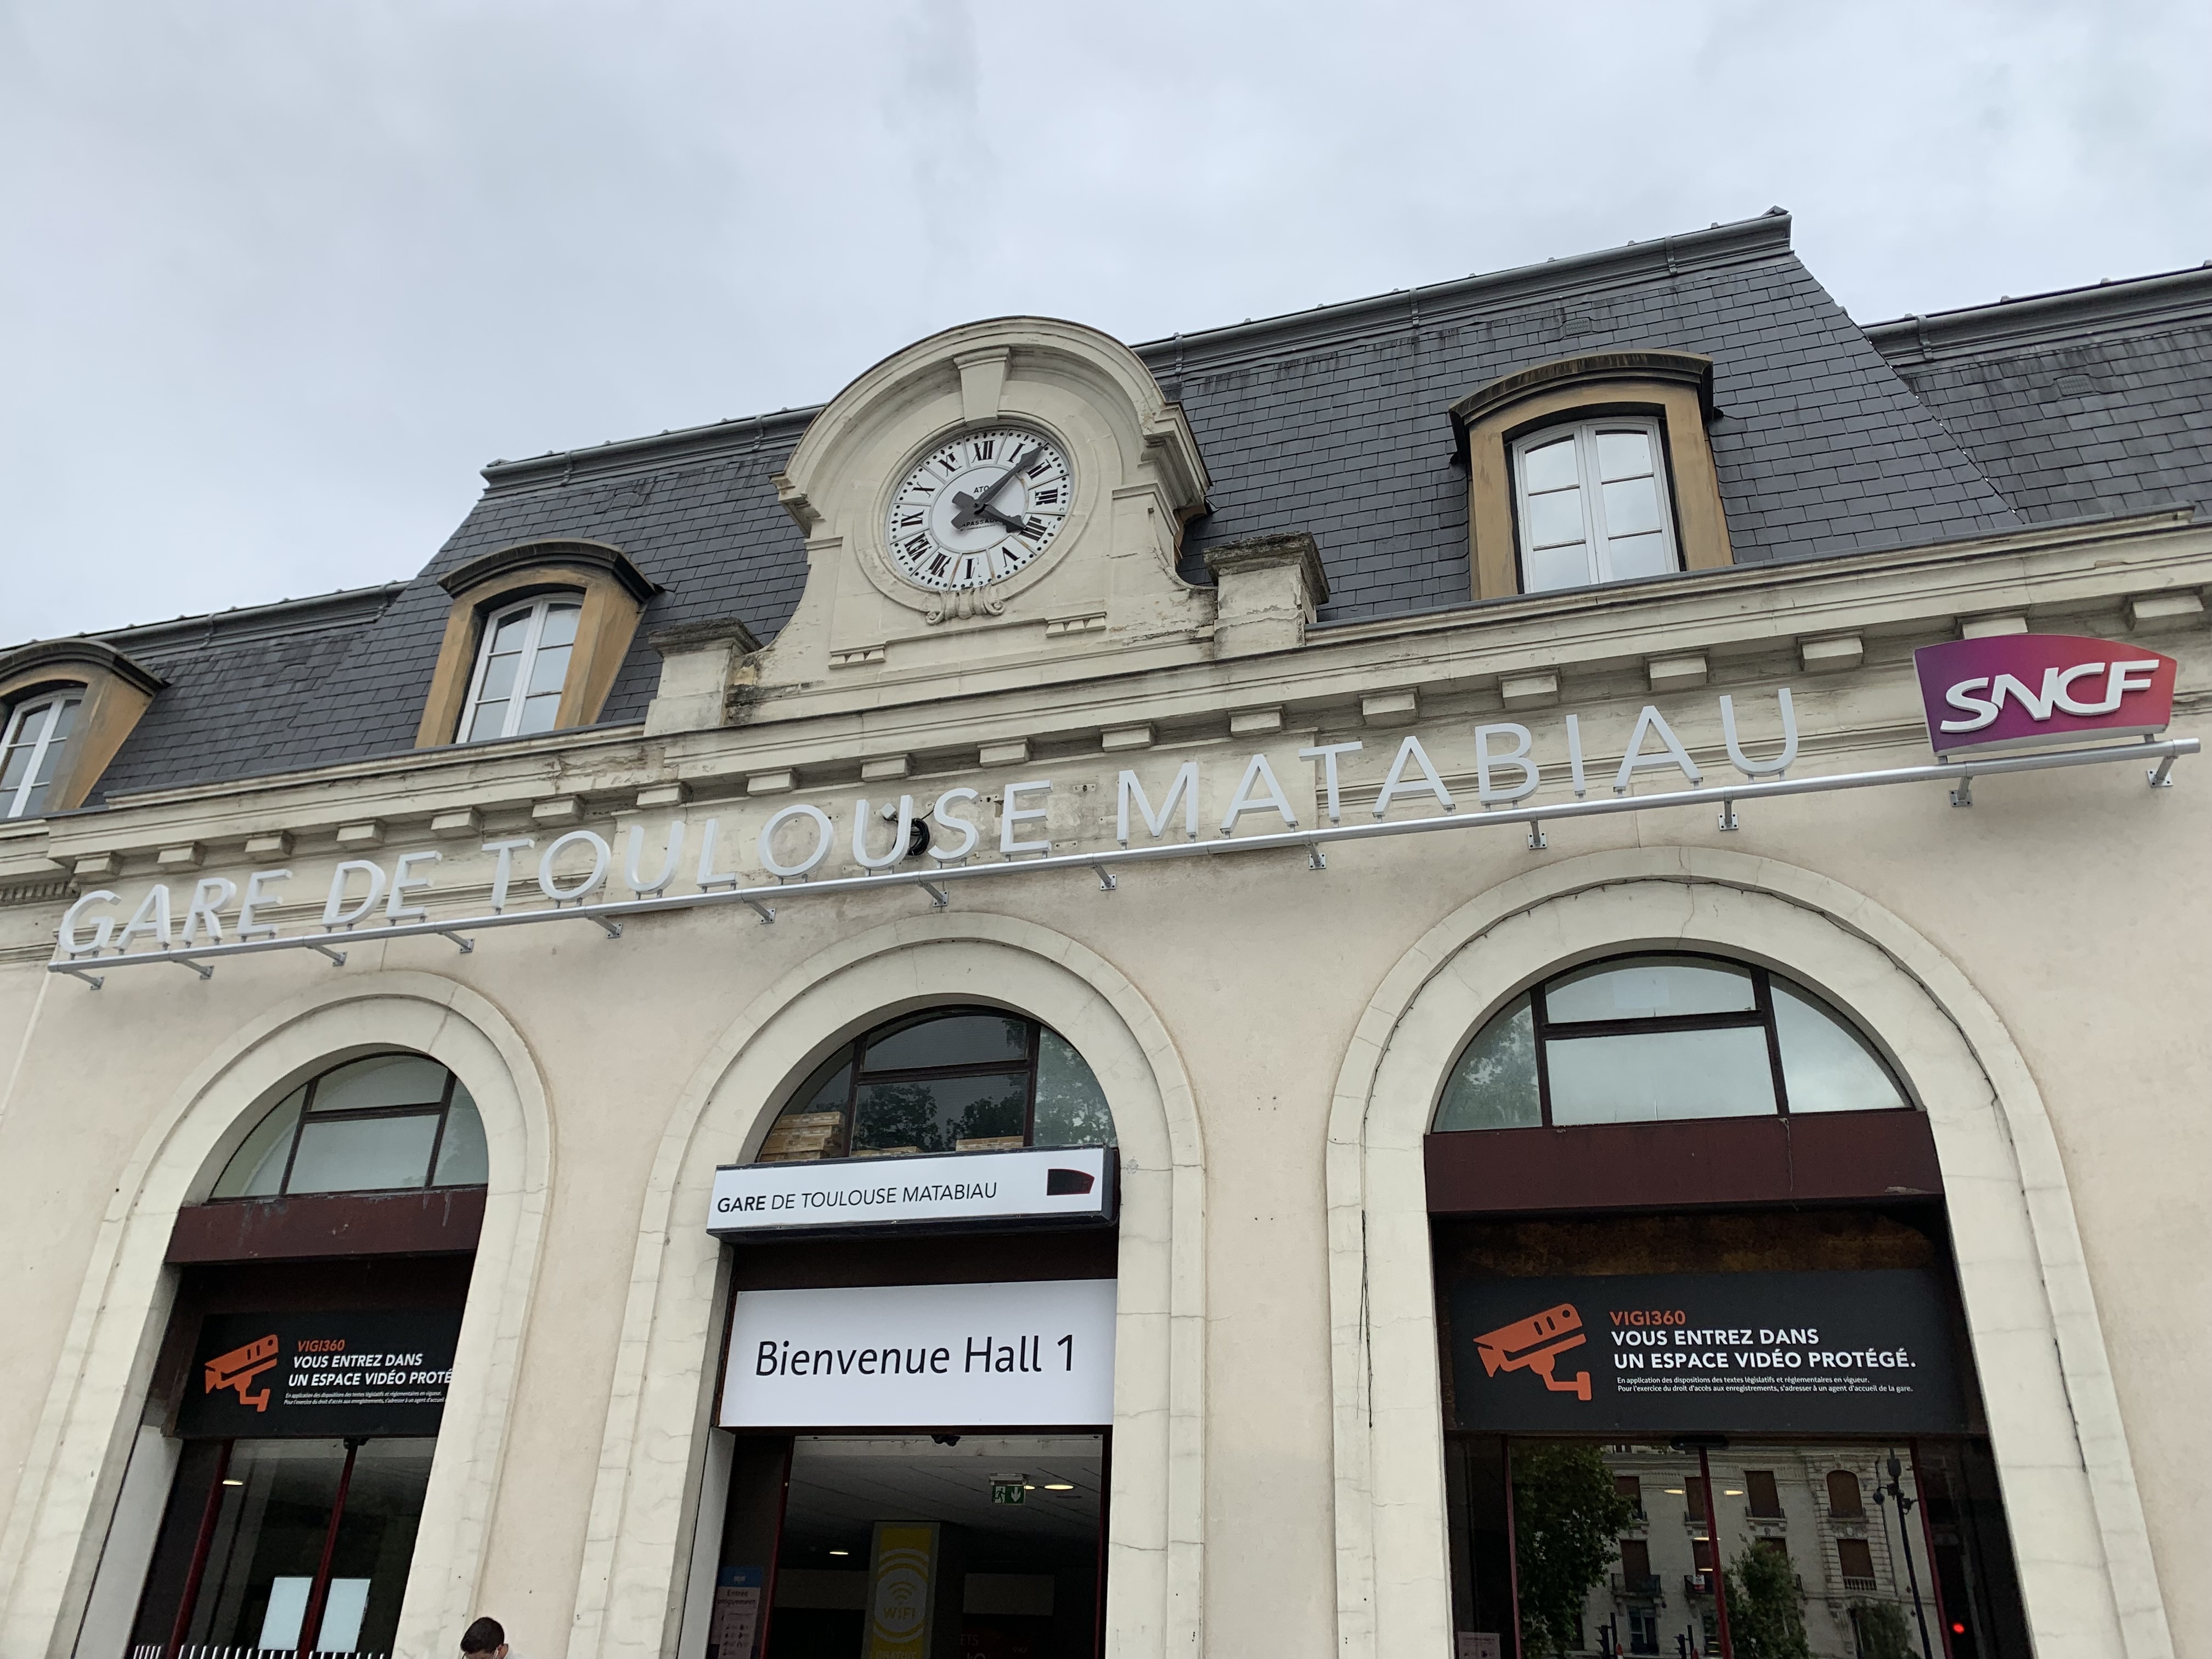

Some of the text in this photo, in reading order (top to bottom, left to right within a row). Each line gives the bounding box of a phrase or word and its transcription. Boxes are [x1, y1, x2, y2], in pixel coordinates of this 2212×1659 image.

[971, 439, 995, 464] XII
[1940, 659, 2160, 733] SNCF
[58, 687, 1799, 955] GARE DE TOULOUSE MATABIAU
[717, 1182, 997, 1213] GARE DE TOULOUSE MATABIAU
[1610, 1310, 1686, 1326] VIGI360
[298, 1340, 345, 1352] VIGI360
[1611, 1328, 1819, 1346] VOUS ENTREZ DANS
[294, 1353, 423, 1368] VOUS ENTREZ DANS
[755, 1334, 1074, 1376] Bienvenue Hall 1
[1614, 1348, 1916, 1369] UN ESPACE VIDÉO PROTÉGÉ.
[289, 1374, 308, 1386] UN
[311, 1373, 362, 1386] ESPACE
[365, 1369, 407, 1385] VIDÉO
[1674, 1376, 1711, 1385] dispositions
